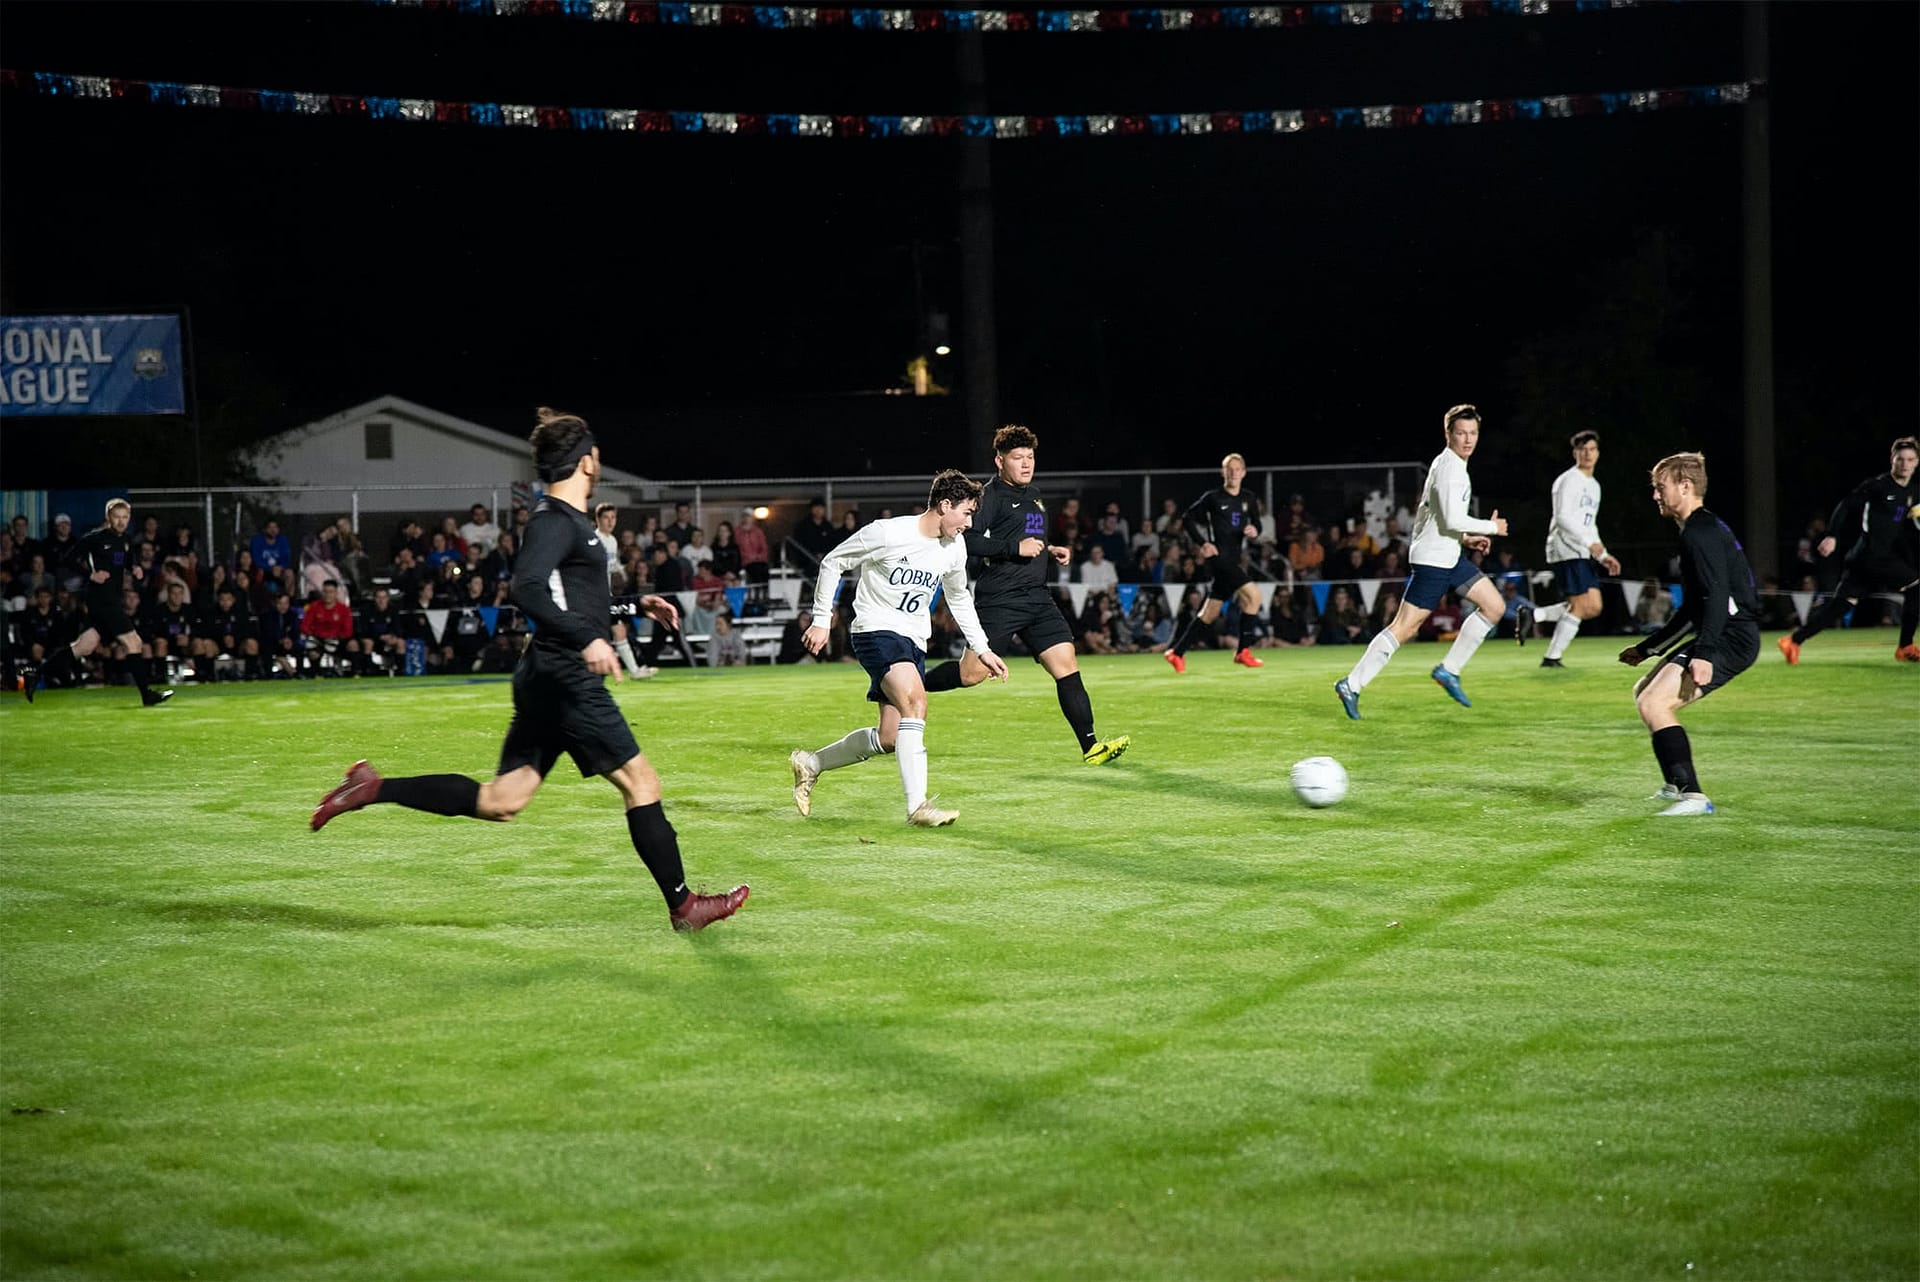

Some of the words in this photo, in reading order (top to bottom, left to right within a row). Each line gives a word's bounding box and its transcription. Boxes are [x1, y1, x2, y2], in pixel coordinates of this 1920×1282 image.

[4, 327, 113, 364] ONAL
[1024, 512, 1045, 534] 22
[1231, 512, 1240, 527] 5
[895, 591, 925, 613] 16
